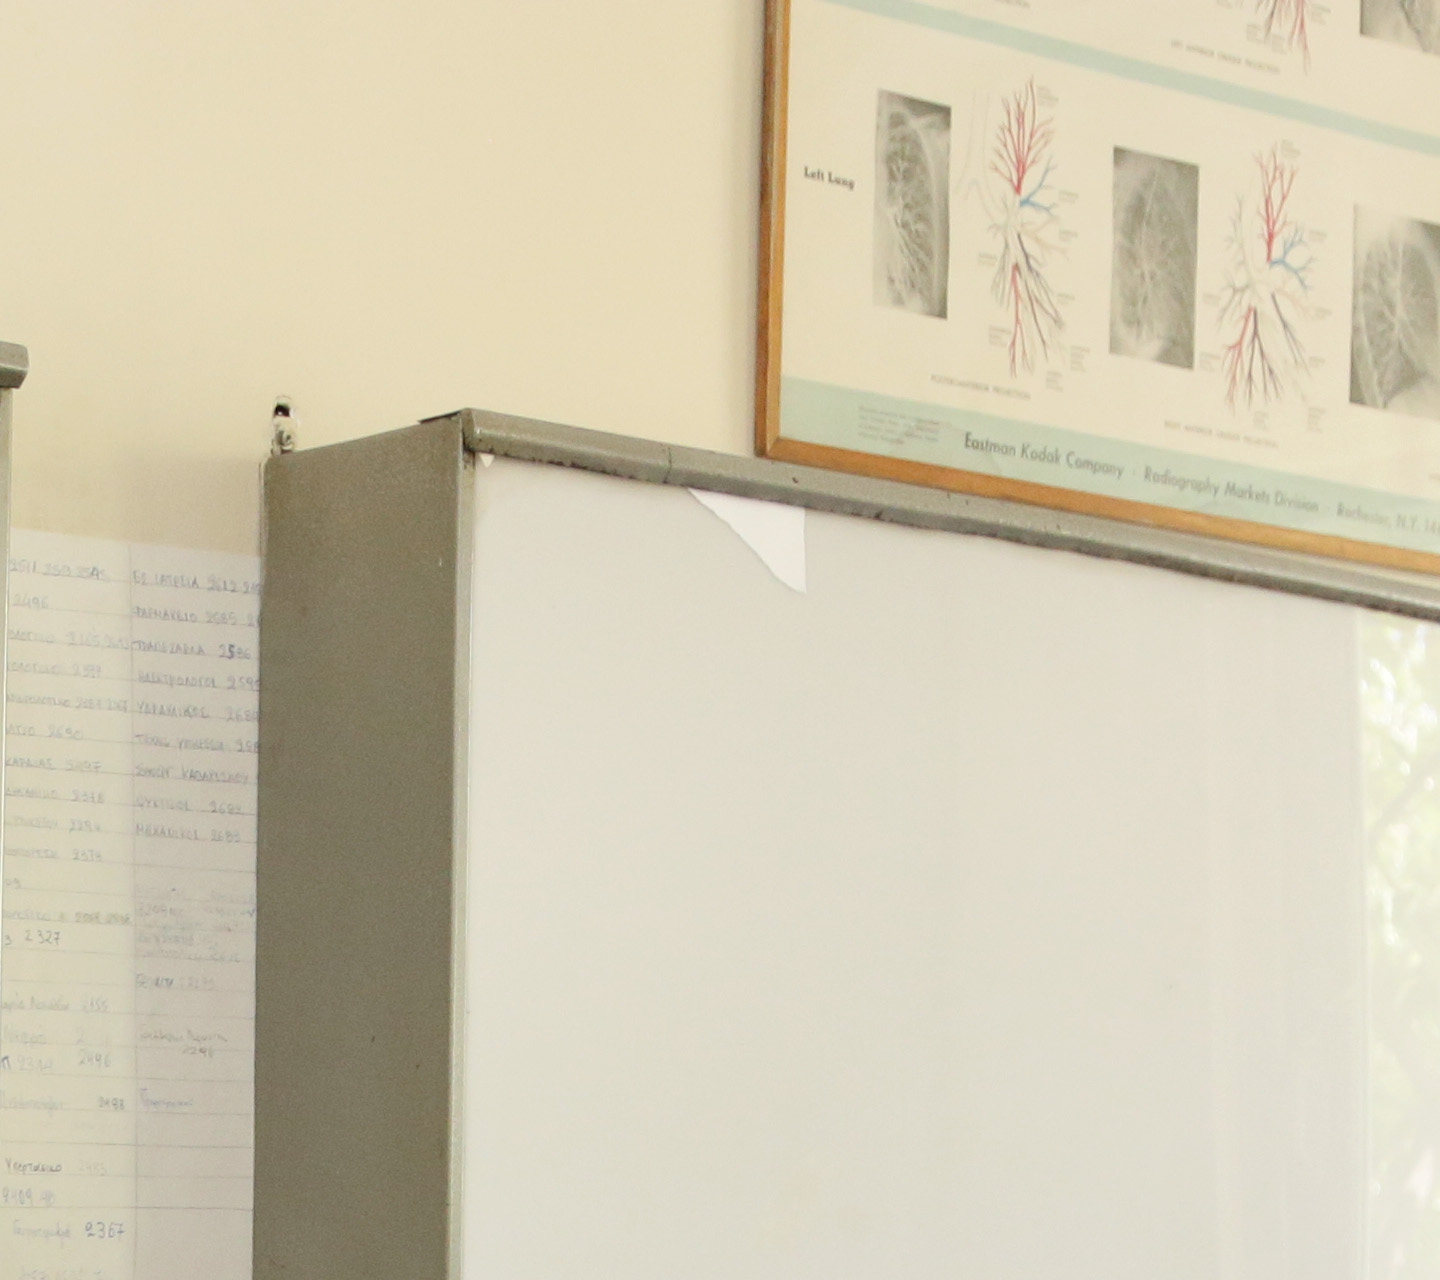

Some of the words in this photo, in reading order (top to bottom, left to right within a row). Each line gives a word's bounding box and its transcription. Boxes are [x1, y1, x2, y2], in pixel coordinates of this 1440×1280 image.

[803, 164, 825, 180] Left
[827, 171, 855, 191] Lung
[963, 431, 1017, 458] Eastman
[1020, 442, 1061, 466] Kodak
[1065, 450, 1125, 480] Company
[1143, 465, 1220, 498] Radiography
[1224, 480, 1271, 505] Markets
[1275, 490, 1320, 513] Division
[1335, 500, 1392, 527] Rochester,
[1395, 512, 1420, 533] N.Y.
[25, 929, 62, 945] 2327
[85, 1221, 126, 1238] 2367
